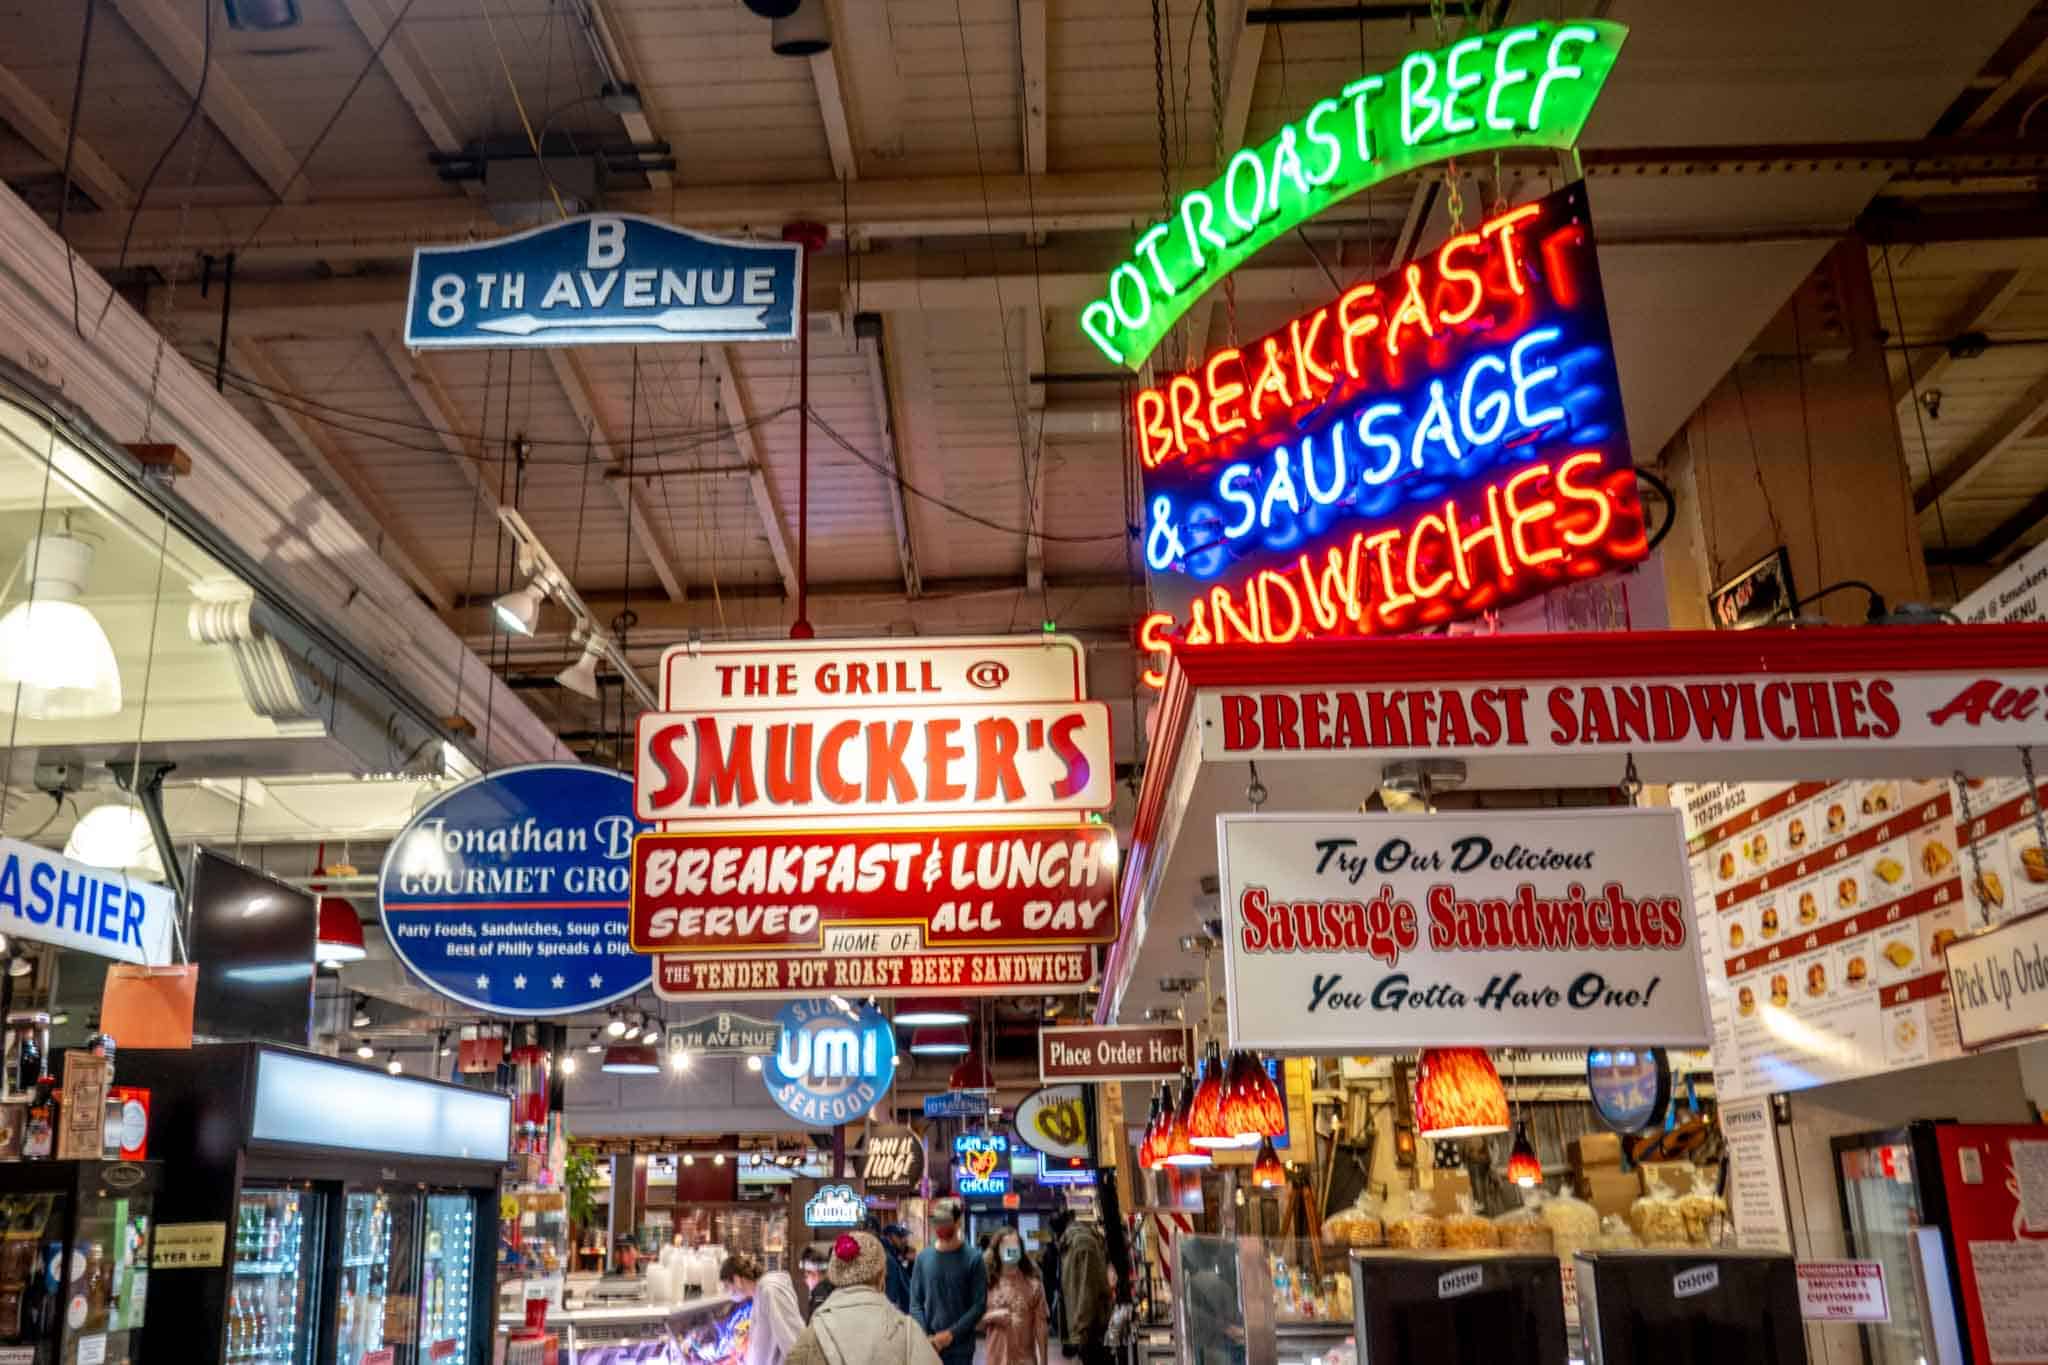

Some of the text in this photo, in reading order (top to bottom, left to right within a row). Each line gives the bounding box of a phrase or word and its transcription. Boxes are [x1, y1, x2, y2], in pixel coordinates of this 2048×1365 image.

[1081, 27, 1598, 365] POT ROAST BEEF
[586, 218, 627, 269] B
[427, 266, 776, 328] 8TH AVENUE
[1136, 203, 1541, 468] BREAKFAST
[1146, 328, 1564, 569] & SAUSAGE
[1141, 452, 1609, 690] SANDWICHES
[715, 659, 1010, 697] THE GRILL @
[1221, 679, 2040, 752] BREAKFAST SANDWICHES All
[649, 712, 1091, 810] SMUCKER'S
[400, 865, 556, 896] GOURMET
[643, 841, 922, 898] BREAKFAST
[950, 837, 1100, 891] LUNCH
[1314, 835, 1596, 886] Try Our Delicious
[397, 920, 630, 938] Party Foods, Sandwiches, Soup City
[648, 898, 1108, 938] SERVED ALL DAY
[832, 933, 880, 952] HOME
[1240, 881, 1688, 968] Sausage Sandwiches
[447, 942, 476, 956] Best
[480, 941, 494, 955] of
[498, 940, 533, 957] Philly
[536, 940, 590, 956] Spreads
[608, 941, 634, 956] Dip
[665, 954, 1085, 990] THE TENDER POT ROAST BEEF SANDWICH
[1307, 972, 1661, 1012] You Gotta Have One!
[1954, 961, 1989, 1012] Pick
[1986, 954, 2012, 1012] Up
[706, 1029, 776, 1047] AVENUE
[1050, 1041, 1092, 1067] Place
[1097, 1040, 1144, 1065] Order
[778, 1082, 875, 1121] SEAFOOD
